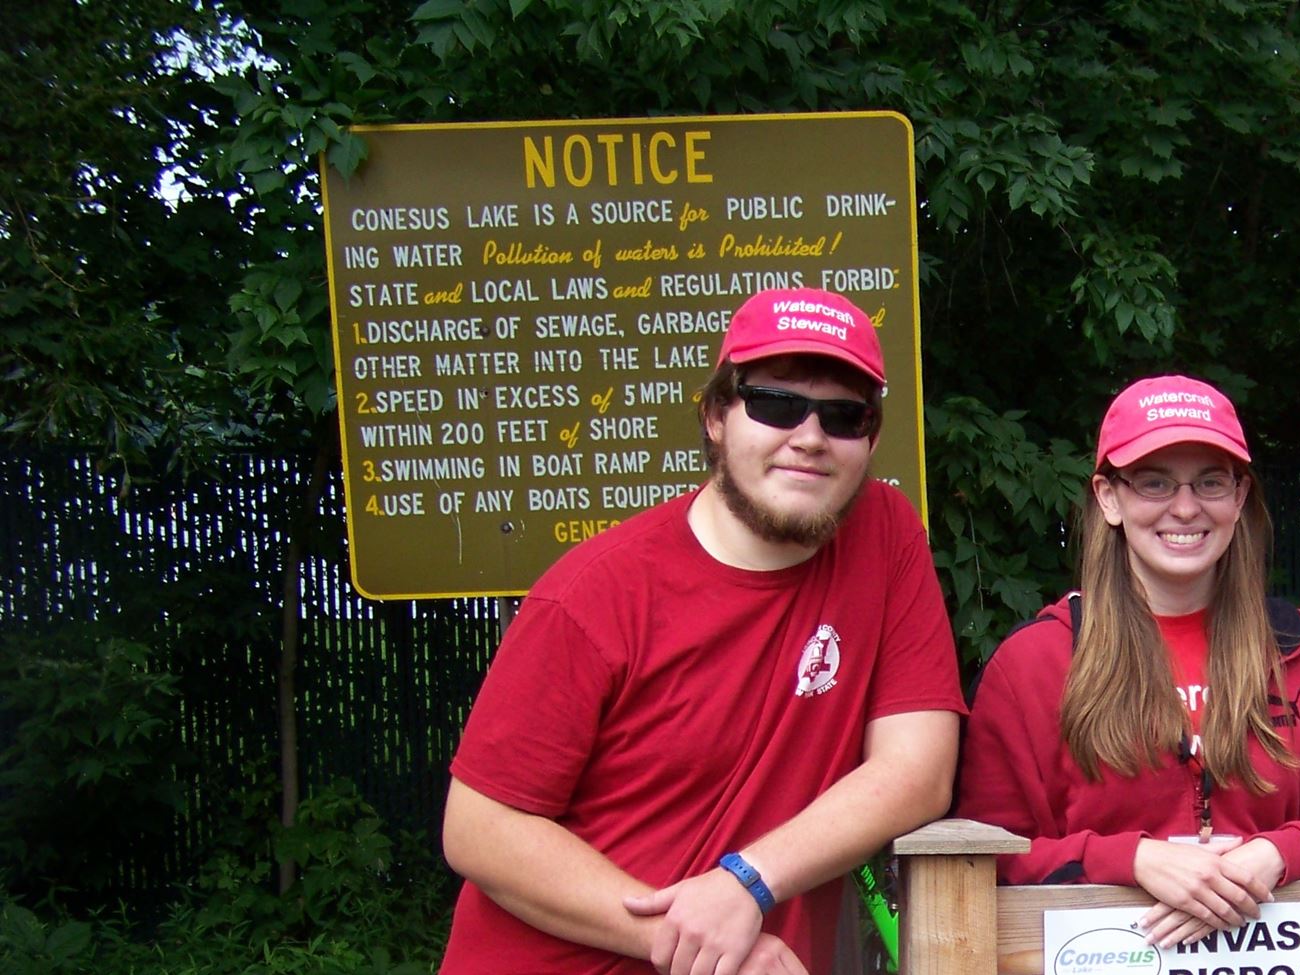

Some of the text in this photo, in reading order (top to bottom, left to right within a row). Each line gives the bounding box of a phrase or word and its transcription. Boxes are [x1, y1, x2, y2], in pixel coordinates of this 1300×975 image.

[524, 131, 714, 188] NOTICE
[352, 193, 896, 231] CONESUS LAKE IS A SOURCE for PUBLIC DRINK-
[345, 246, 379, 269] ING
[393, 244, 463, 268] WATER
[483, 240, 573, 266] Pollution
[583, 239, 601, 269] of
[615, 240, 678, 261] waters
[688, 242, 705, 259] is
[350, 283, 418, 307] STATE
[424, 282, 463, 306] and
[471, 279, 539, 303] LOCAL
[552, 277, 608, 301] LAWS
[613, 277, 652, 299] and
[661, 271, 804, 298] REGULATIONS
[496, 317, 521, 339] OF
[536, 313, 624, 338] SEWAGE,
[773, 300, 856, 328] Watercraft
[777, 316, 847, 341] Steward
[354, 345, 709, 379] OTHER MATTER INTO THE LAKE
[458, 388, 479, 410] IN
[495, 385, 580, 409] EXCESS
[591, 387, 613, 414] of
[1139, 392, 1216, 409] Watercraft
[1146, 408, 1212, 422] Steward
[361, 416, 659, 449] WITHIN 200 FEET of SHORE
[499, 455, 520, 477] IN
[532, 453, 583, 477] BOAT
[595, 451, 650, 475] RAMP
[439, 492, 465, 515] OF
[475, 489, 514, 513] ANY
[528, 487, 590, 511] BOATS
[554, 520, 622, 542] GENE
[1059, 949, 1155, 967] Conesus
